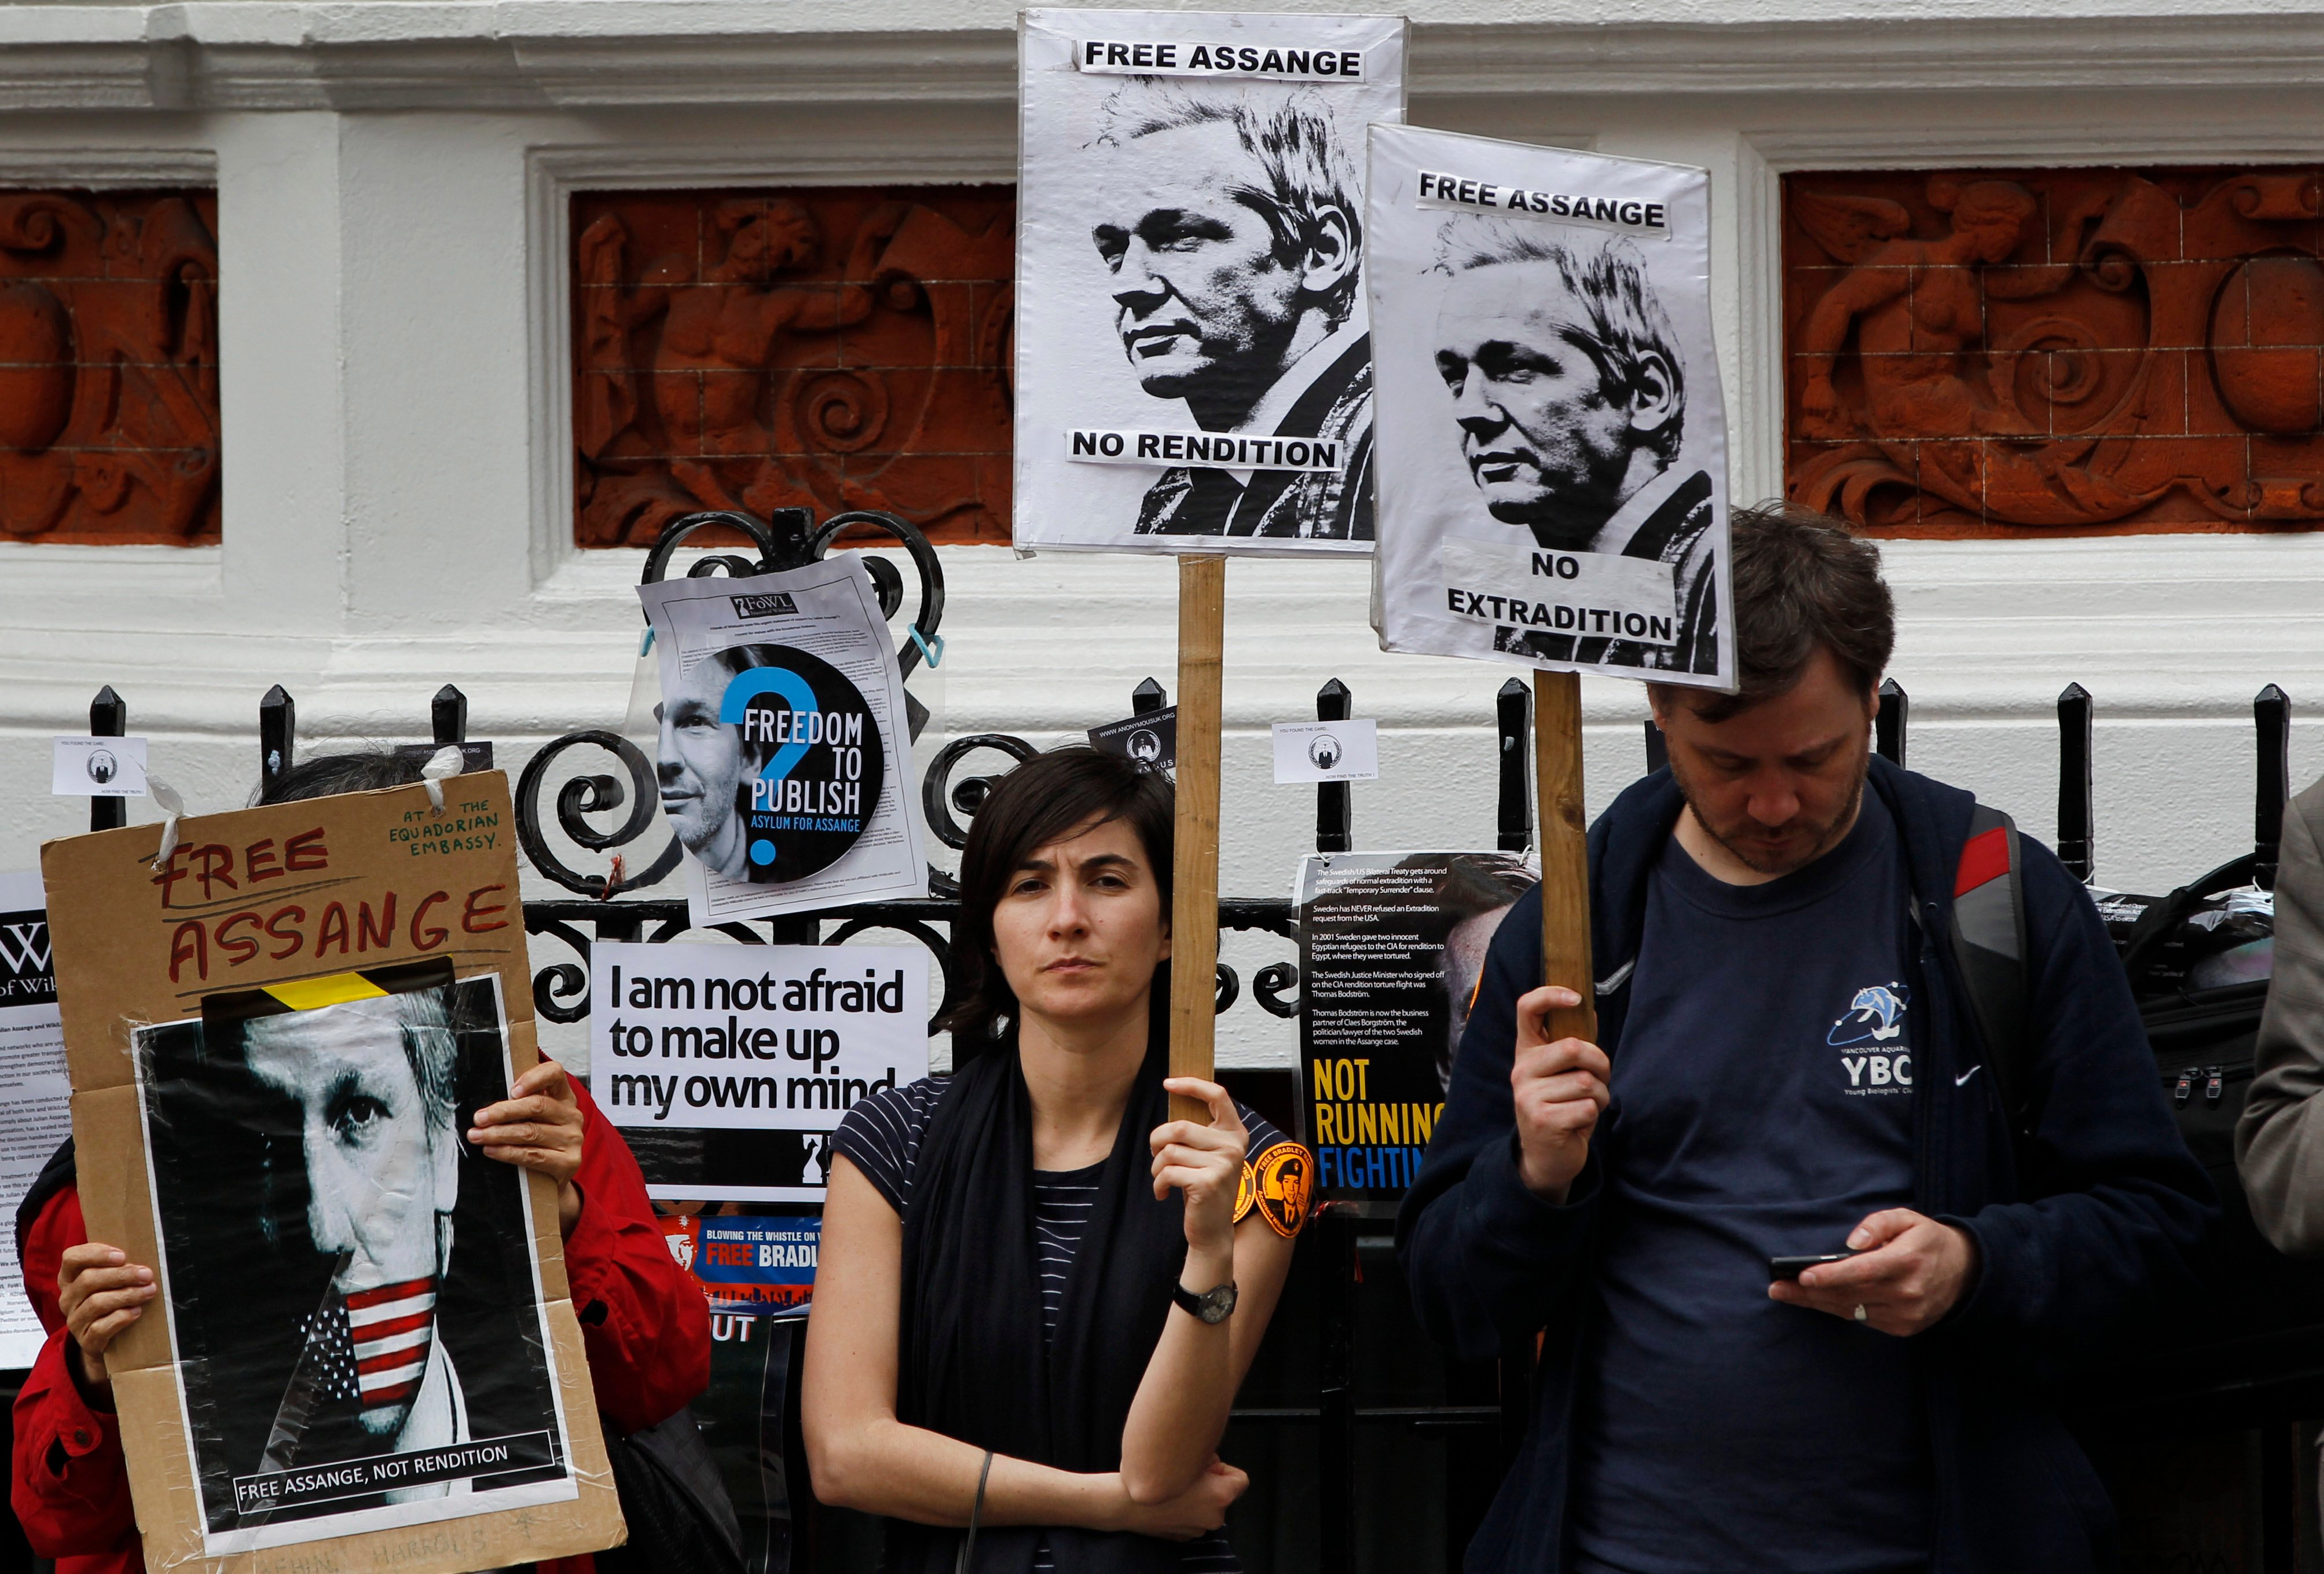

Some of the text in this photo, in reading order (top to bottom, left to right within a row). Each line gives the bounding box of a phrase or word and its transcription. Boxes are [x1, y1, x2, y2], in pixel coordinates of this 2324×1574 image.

[1086, 42, 1360, 76] FREE ASSANGE
[1420, 173, 1665, 228] FREE ASSANGE
[1073, 432, 1336, 467] NO RENDITION
[1532, 552, 1579, 579] NO
[745, 596, 792, 610] FoWL
[1448, 588, 1671, 640] EXTRADITION
[745, 709, 862, 745] FREEDOM
[833, 747, 862, 781] TO
[404, 800, 489, 822] AT THE
[752, 778, 860, 814] PUBLISH
[390, 812, 498, 841] EQUADORIAN
[752, 815, 860, 832] ASYLUM FOR ASSANGE
[151, 827, 328, 908] FREE
[169, 884, 508, 983] ASSANGE
[1313, 914, 1336, 923] request
[1312, 943, 1339, 951] Egyptian
[1340, 943, 1366, 951] refugees
[1353, 953, 1366, 961] they
[612, 965, 903, 1013] I am not afraid
[1396, 981, 1413, 990] flight
[1414, 971, 1435, 980] signed
[1313, 1019, 1336, 1027] partner
[609, 1015, 840, 1074] to make up
[1357, 1038, 1383, 1046] Assange
[1314, 1059, 1369, 1100] NOT
[1841, 1055, 1913, 1086] YBC
[611, 1074, 679, 1120] my
[684, 1075, 777, 1108] own
[1272, 1147, 1303, 1157] BRADLEY
[706, 1230, 815, 1242] BLOWING THE WHISTLE ON
[706, 1242, 754, 1266] FREE
[238, 1445, 508, 1501] FREE ASSANGE, NOT RENDITION
